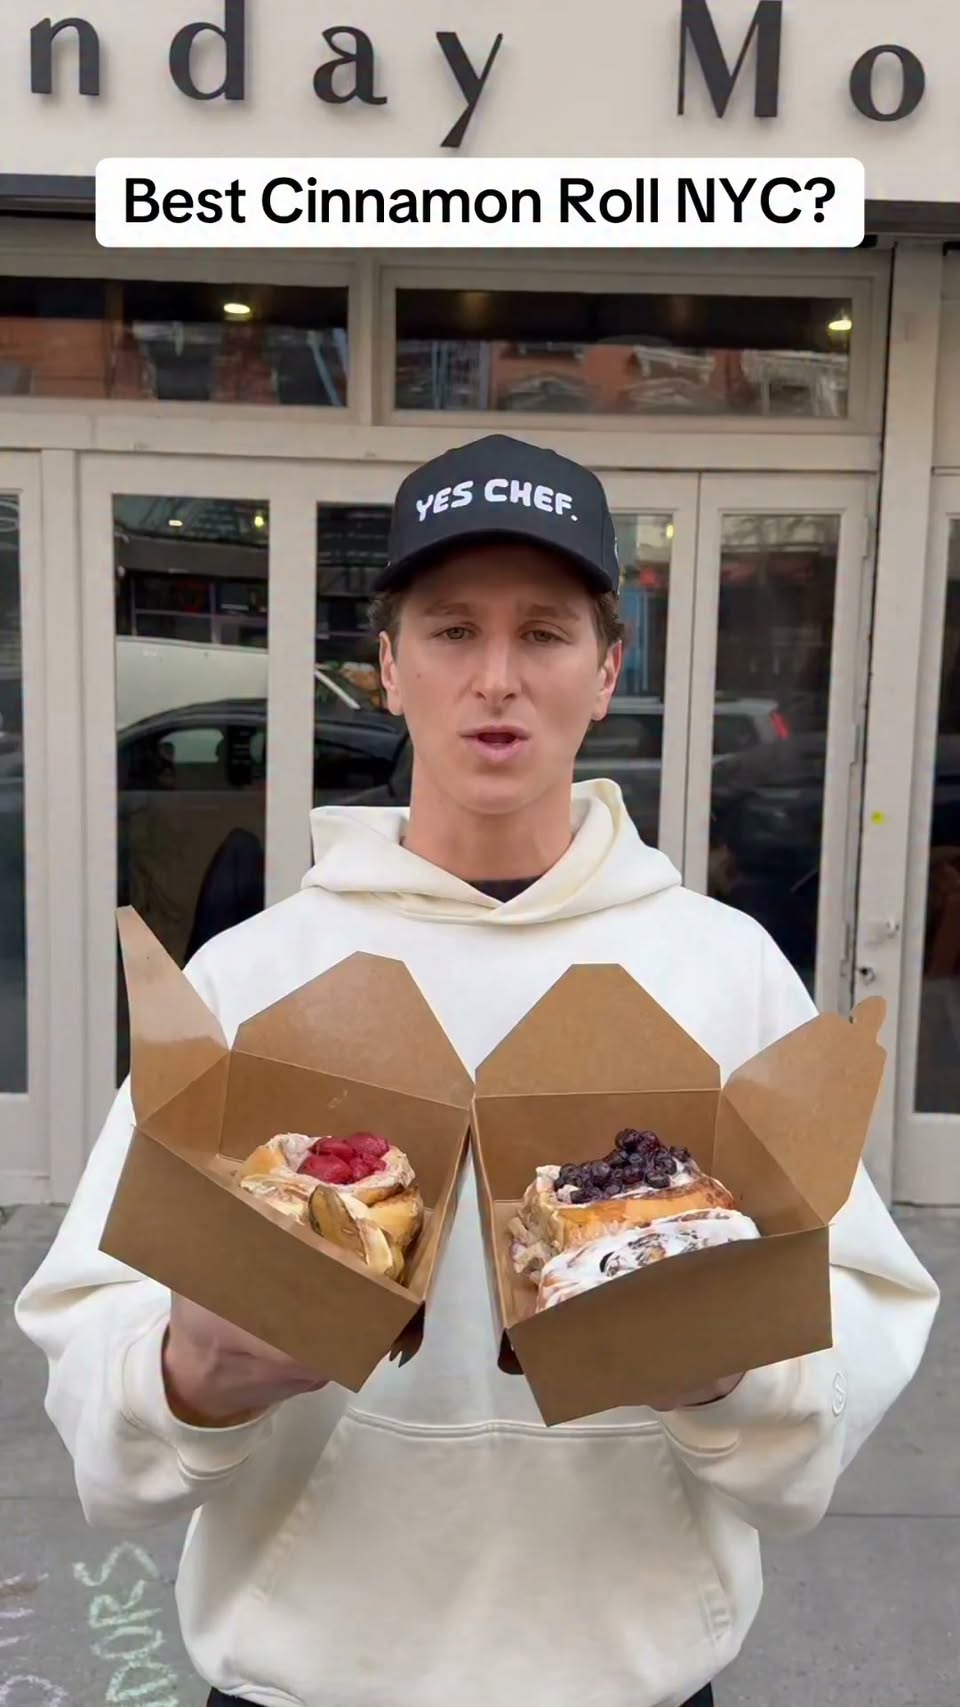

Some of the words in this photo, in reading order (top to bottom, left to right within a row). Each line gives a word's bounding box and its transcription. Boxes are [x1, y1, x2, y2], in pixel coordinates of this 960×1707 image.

[30, 0, 503, 148] nday
[677, 0, 926, 122] Mo
[416, 480, 474, 522] YES
[484, 478, 578, 522] CHEF.
